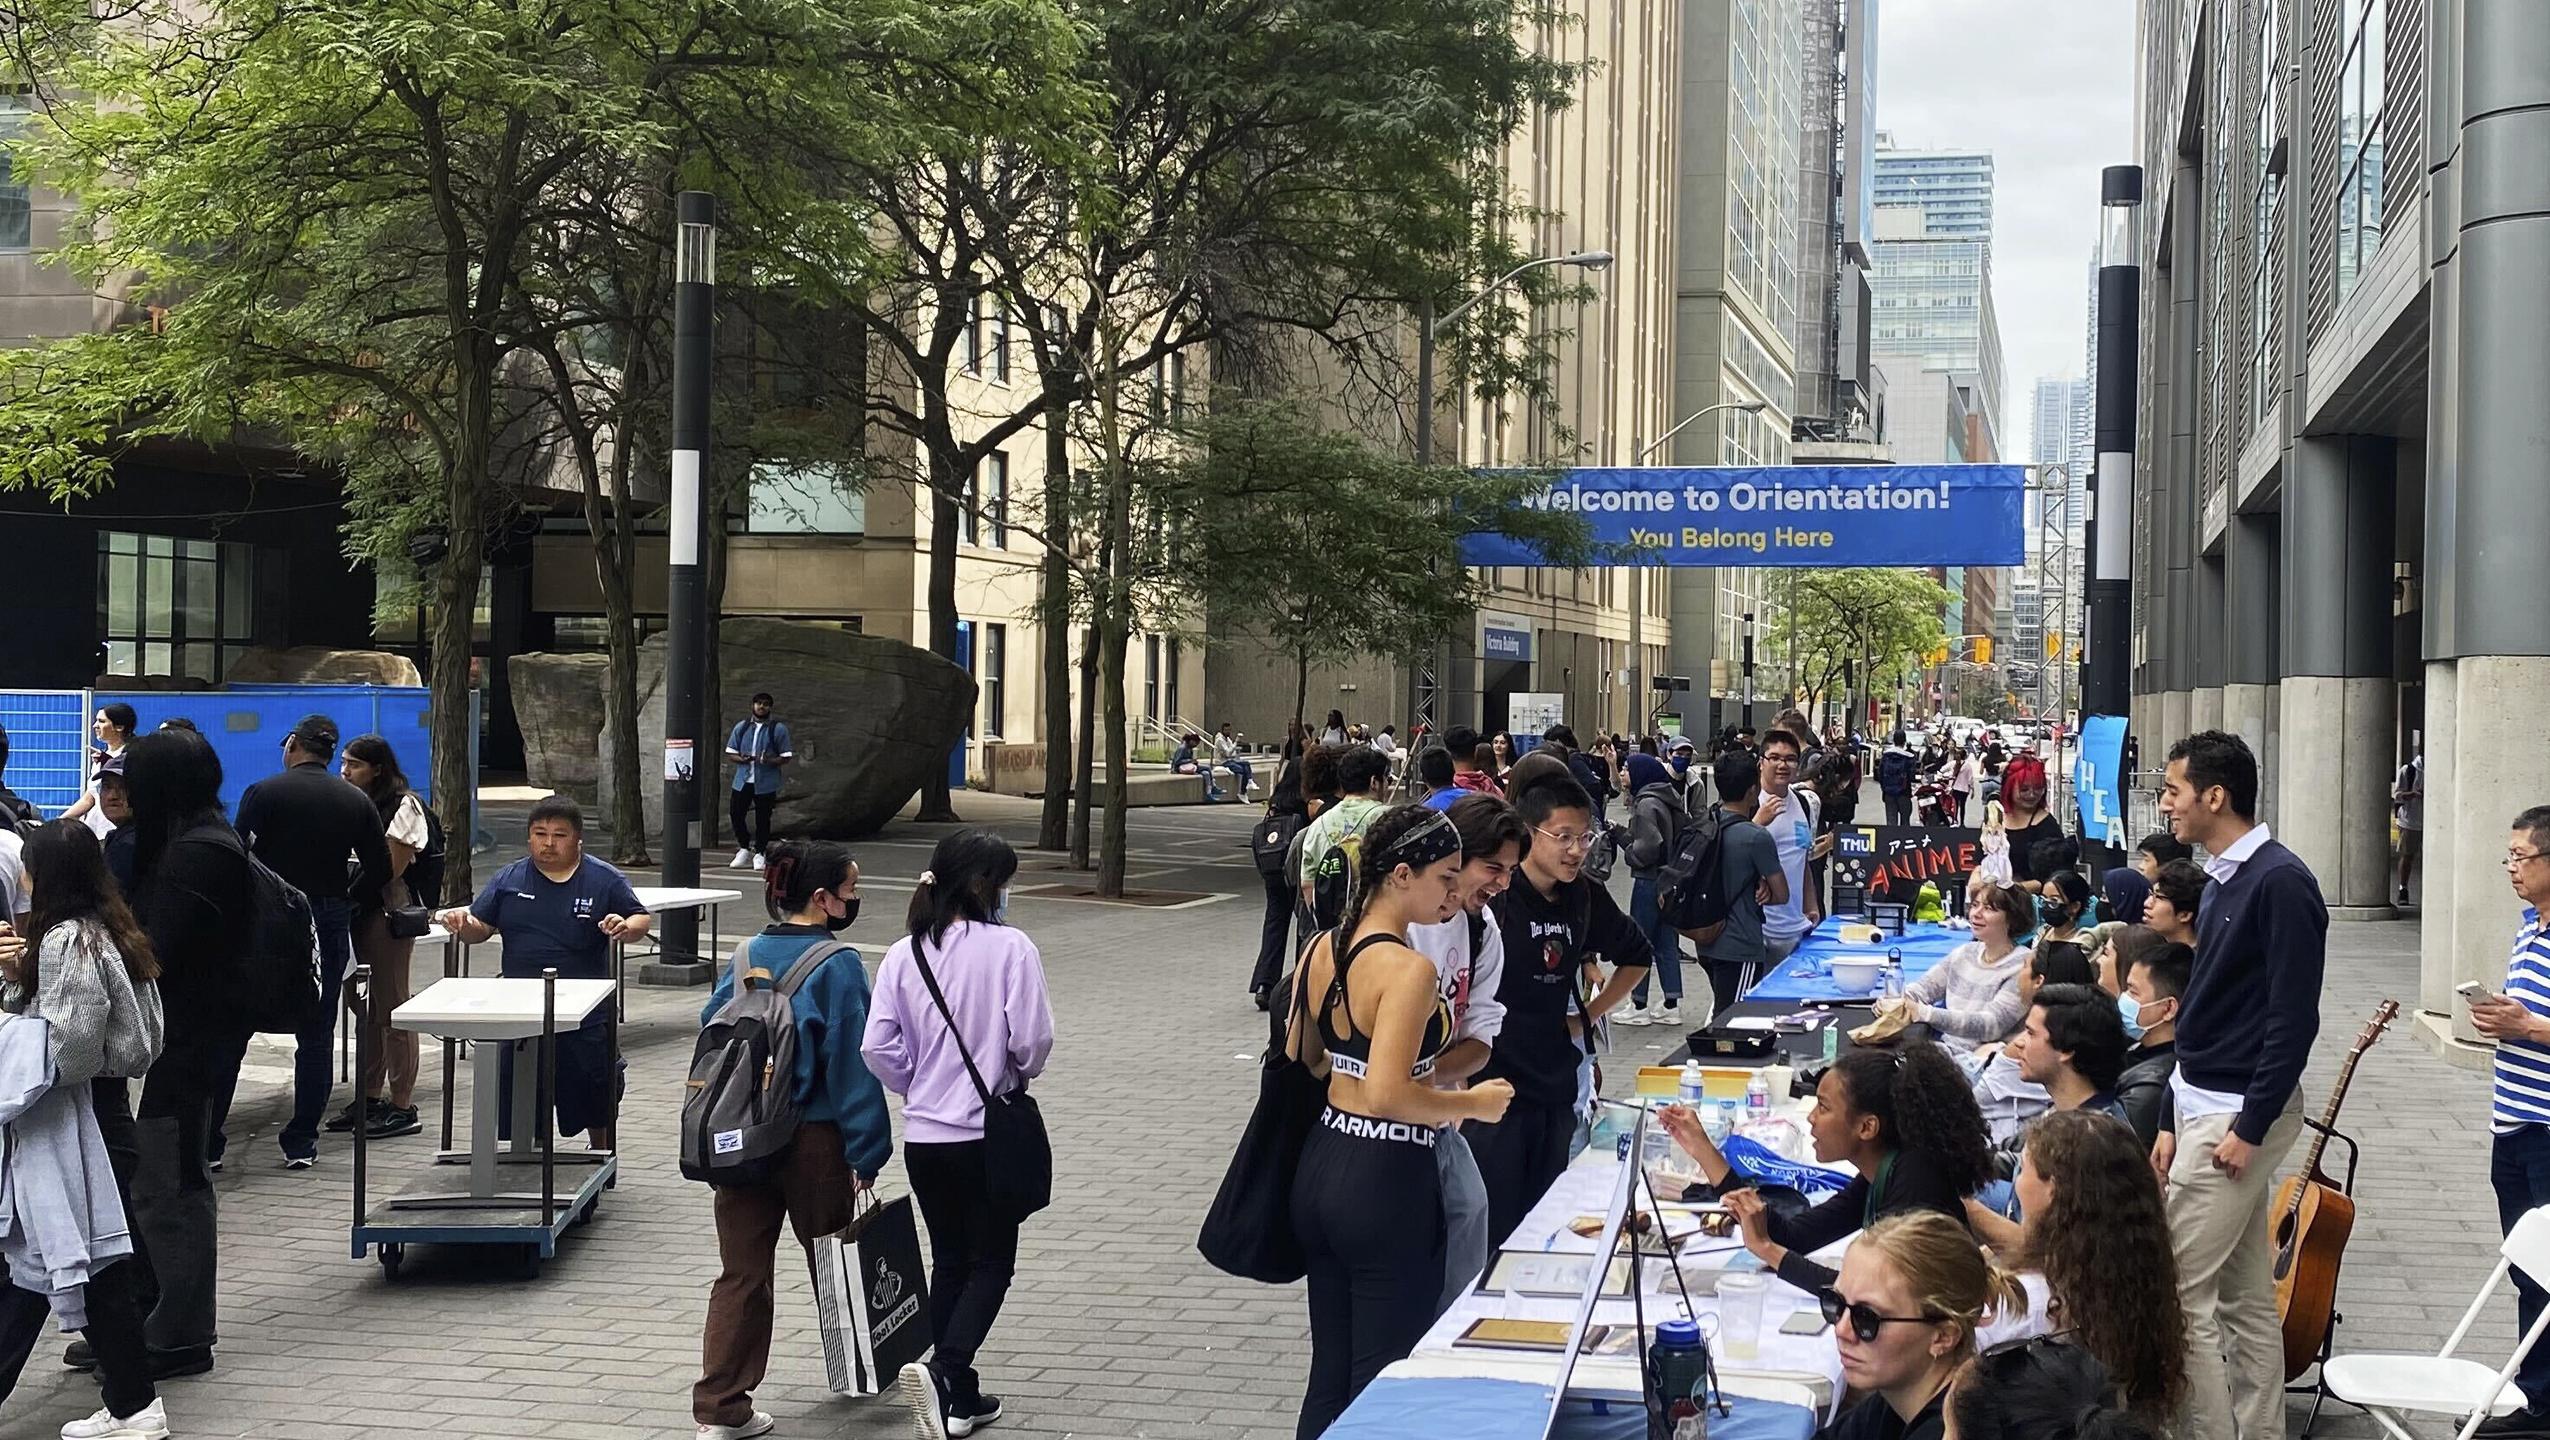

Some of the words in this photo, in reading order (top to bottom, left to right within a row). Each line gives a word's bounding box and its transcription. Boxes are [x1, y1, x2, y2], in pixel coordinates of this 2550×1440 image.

[1519, 483, 1675, 512] Welcome
[1684, 486, 1720, 512] to
[1728, 481, 1950, 512] Orientation!
[1630, 528, 1673, 549] You
[1681, 526, 1767, 553] Belong
[1775, 526, 1834, 548] Here
[1840, 838, 1870, 851] TMU
[1869, 842, 1976, 896] ANIME
